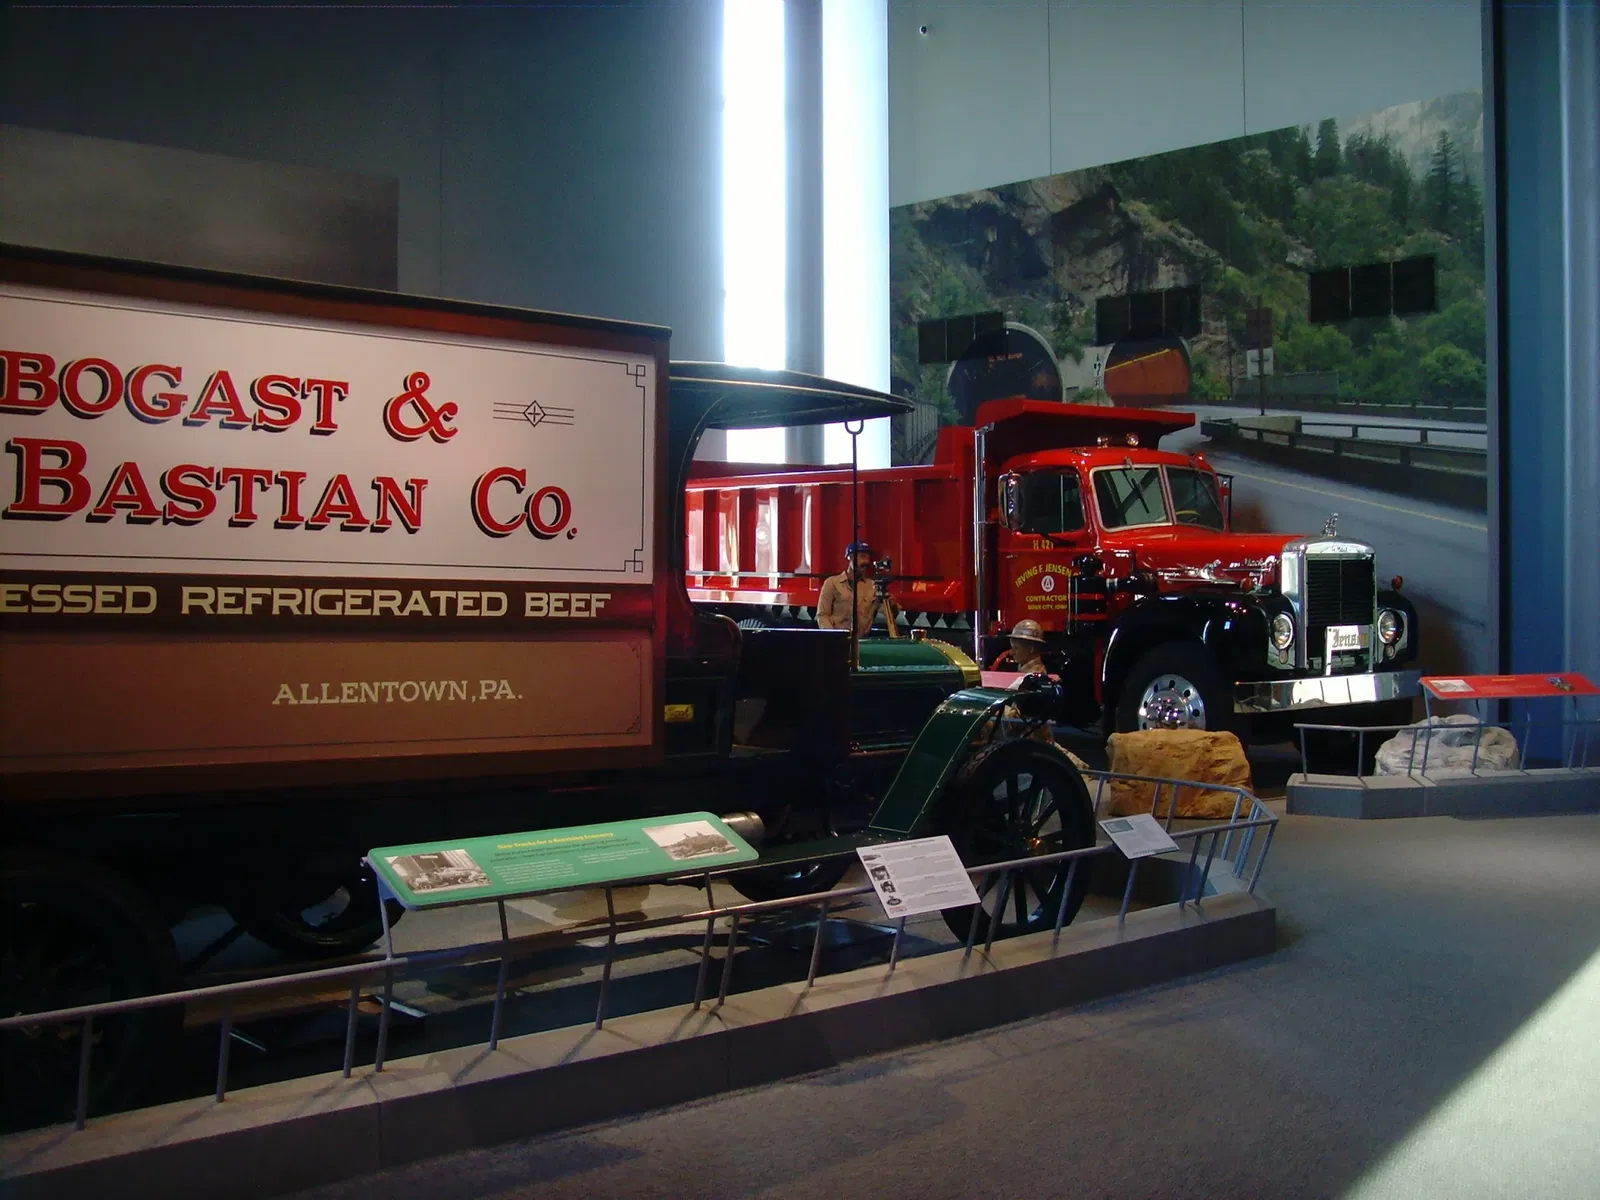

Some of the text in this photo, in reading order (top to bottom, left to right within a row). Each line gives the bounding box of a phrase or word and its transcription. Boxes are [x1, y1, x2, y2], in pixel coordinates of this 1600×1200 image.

[0, 350, 459, 444] BOGAST &
[2, 437, 429, 534] BASTIAN
[0, 584, 611, 618] ESSED REFRIGERATED BEEF
[1015, 565, 1038, 588] IRVING
[1045, 564, 1072, 577] JENSEN
